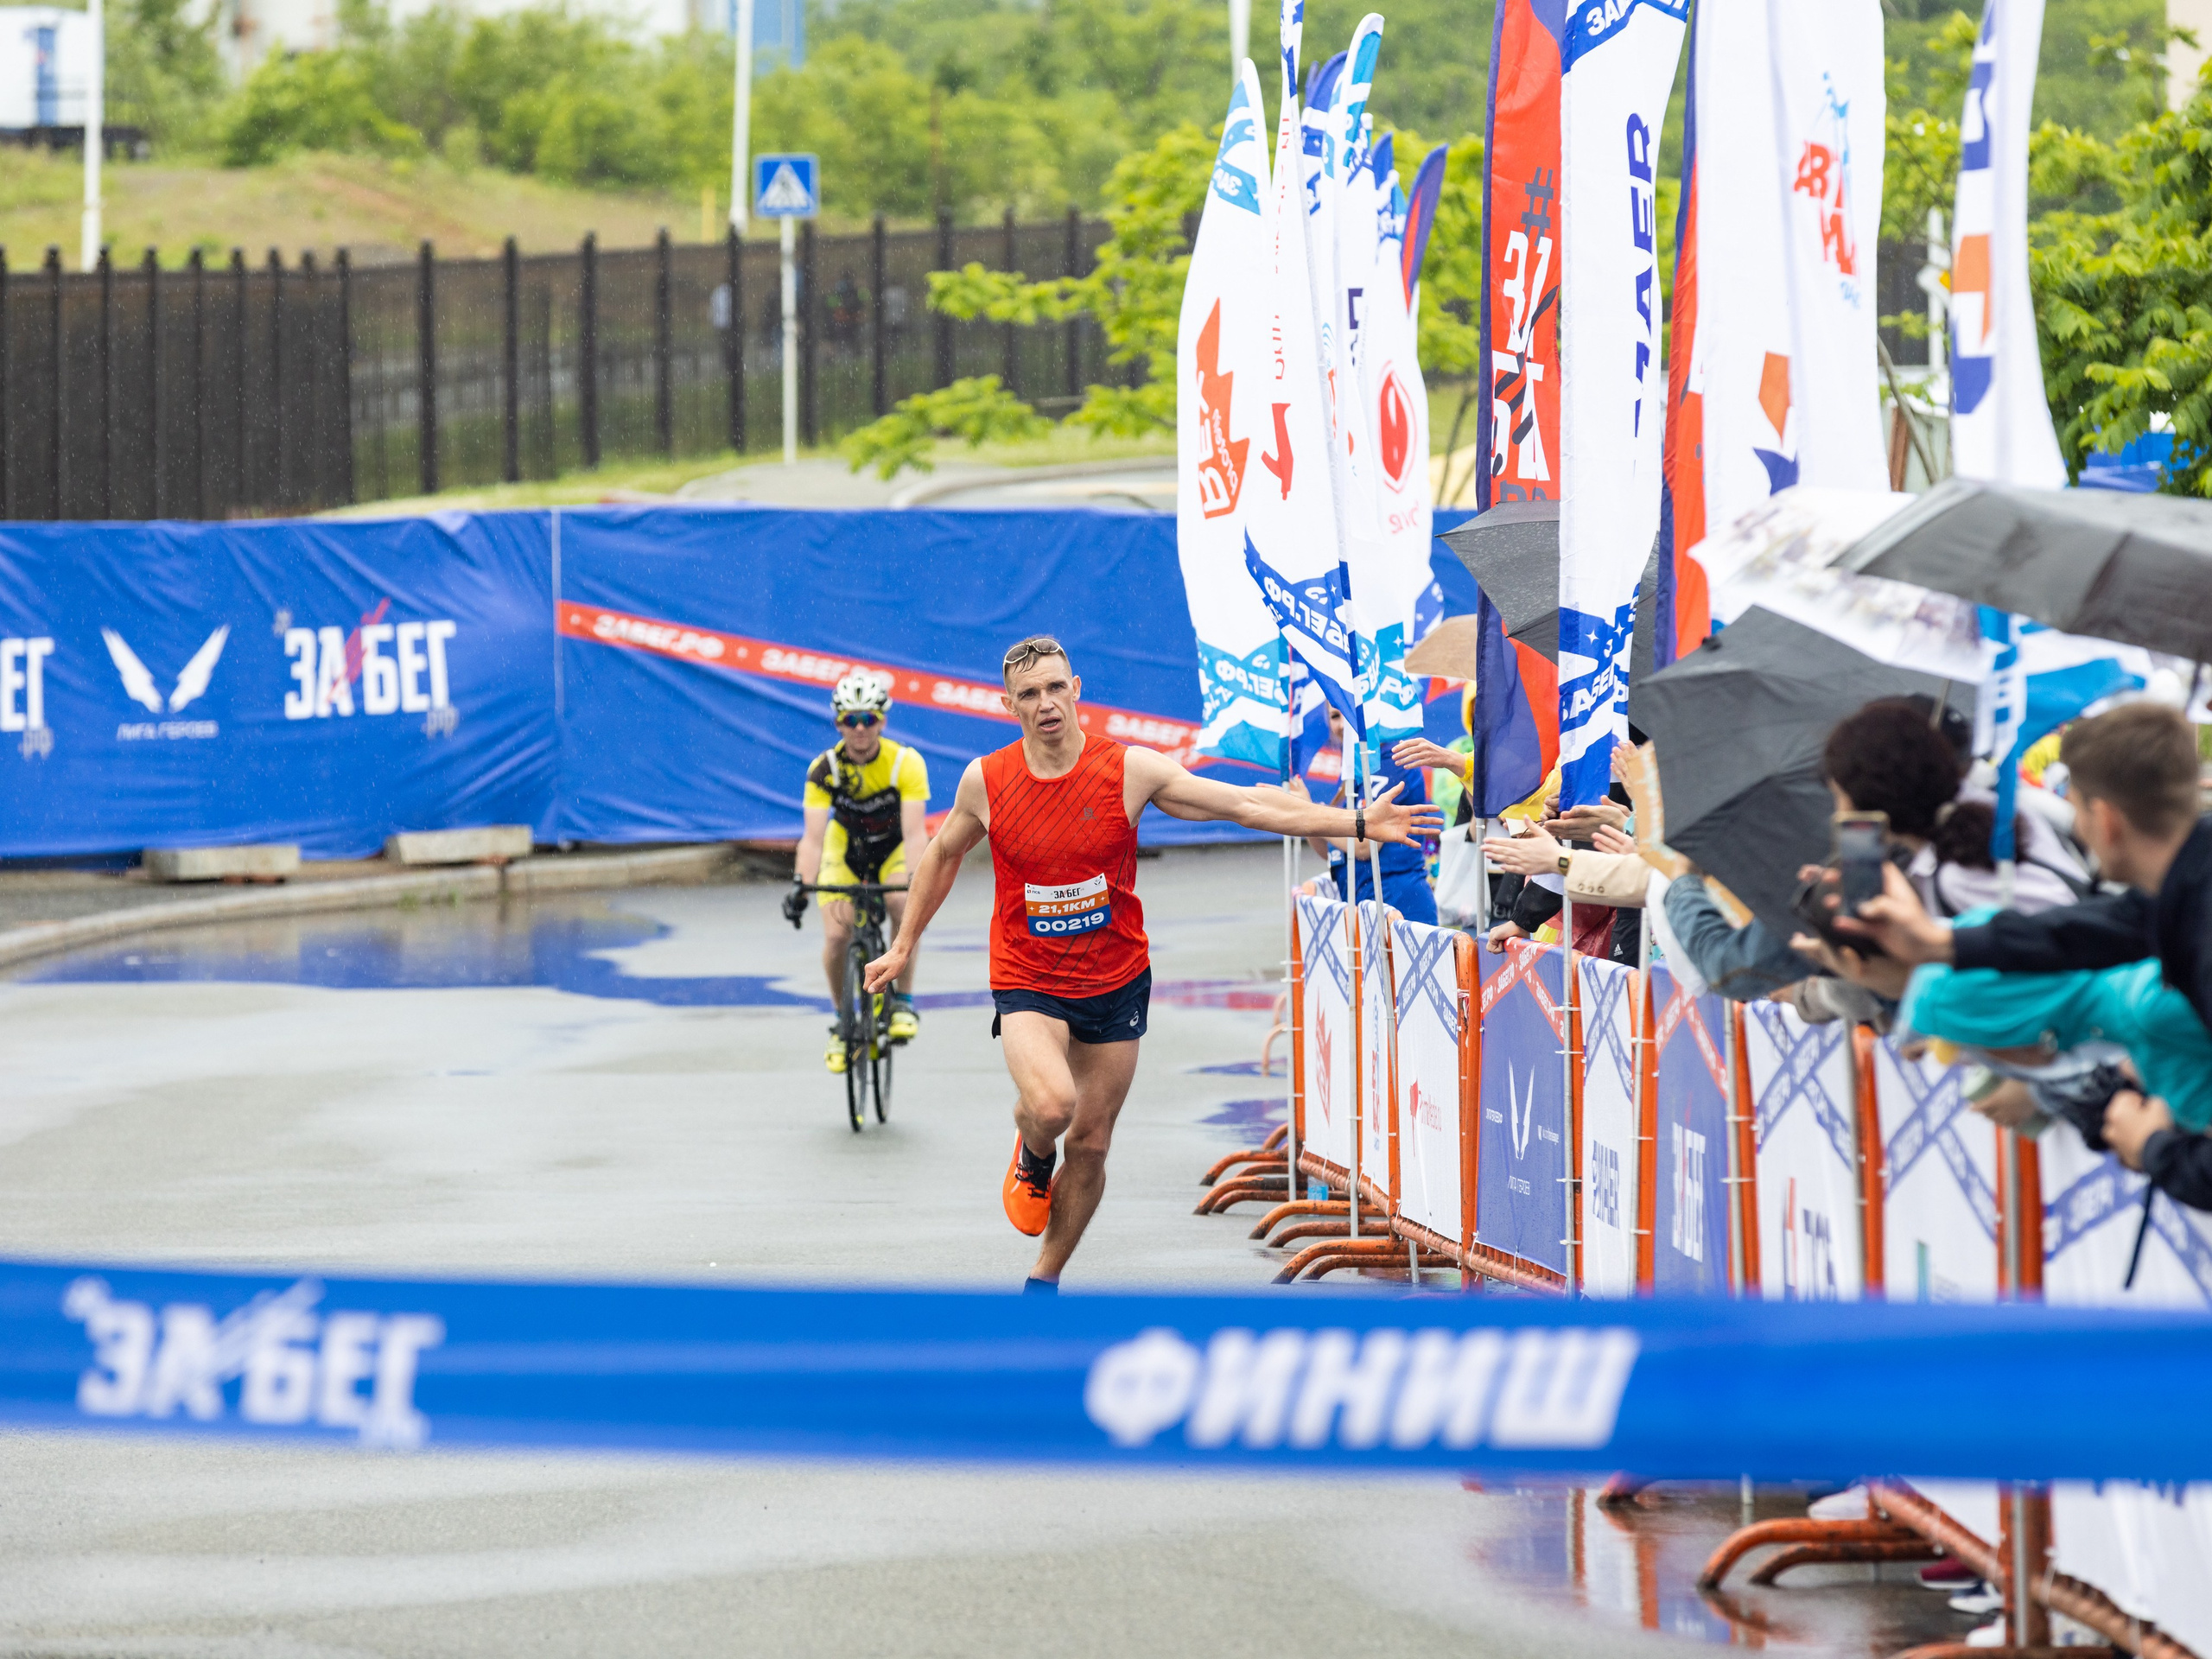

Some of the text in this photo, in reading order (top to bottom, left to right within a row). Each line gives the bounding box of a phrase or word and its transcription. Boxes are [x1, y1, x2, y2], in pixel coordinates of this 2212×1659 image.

[761, 648, 894, 690] ЗАБЕГРФ
[1035, 912, 1105, 932] 00219
[1084, 1325, 1639, 1449] ФИНИШ
